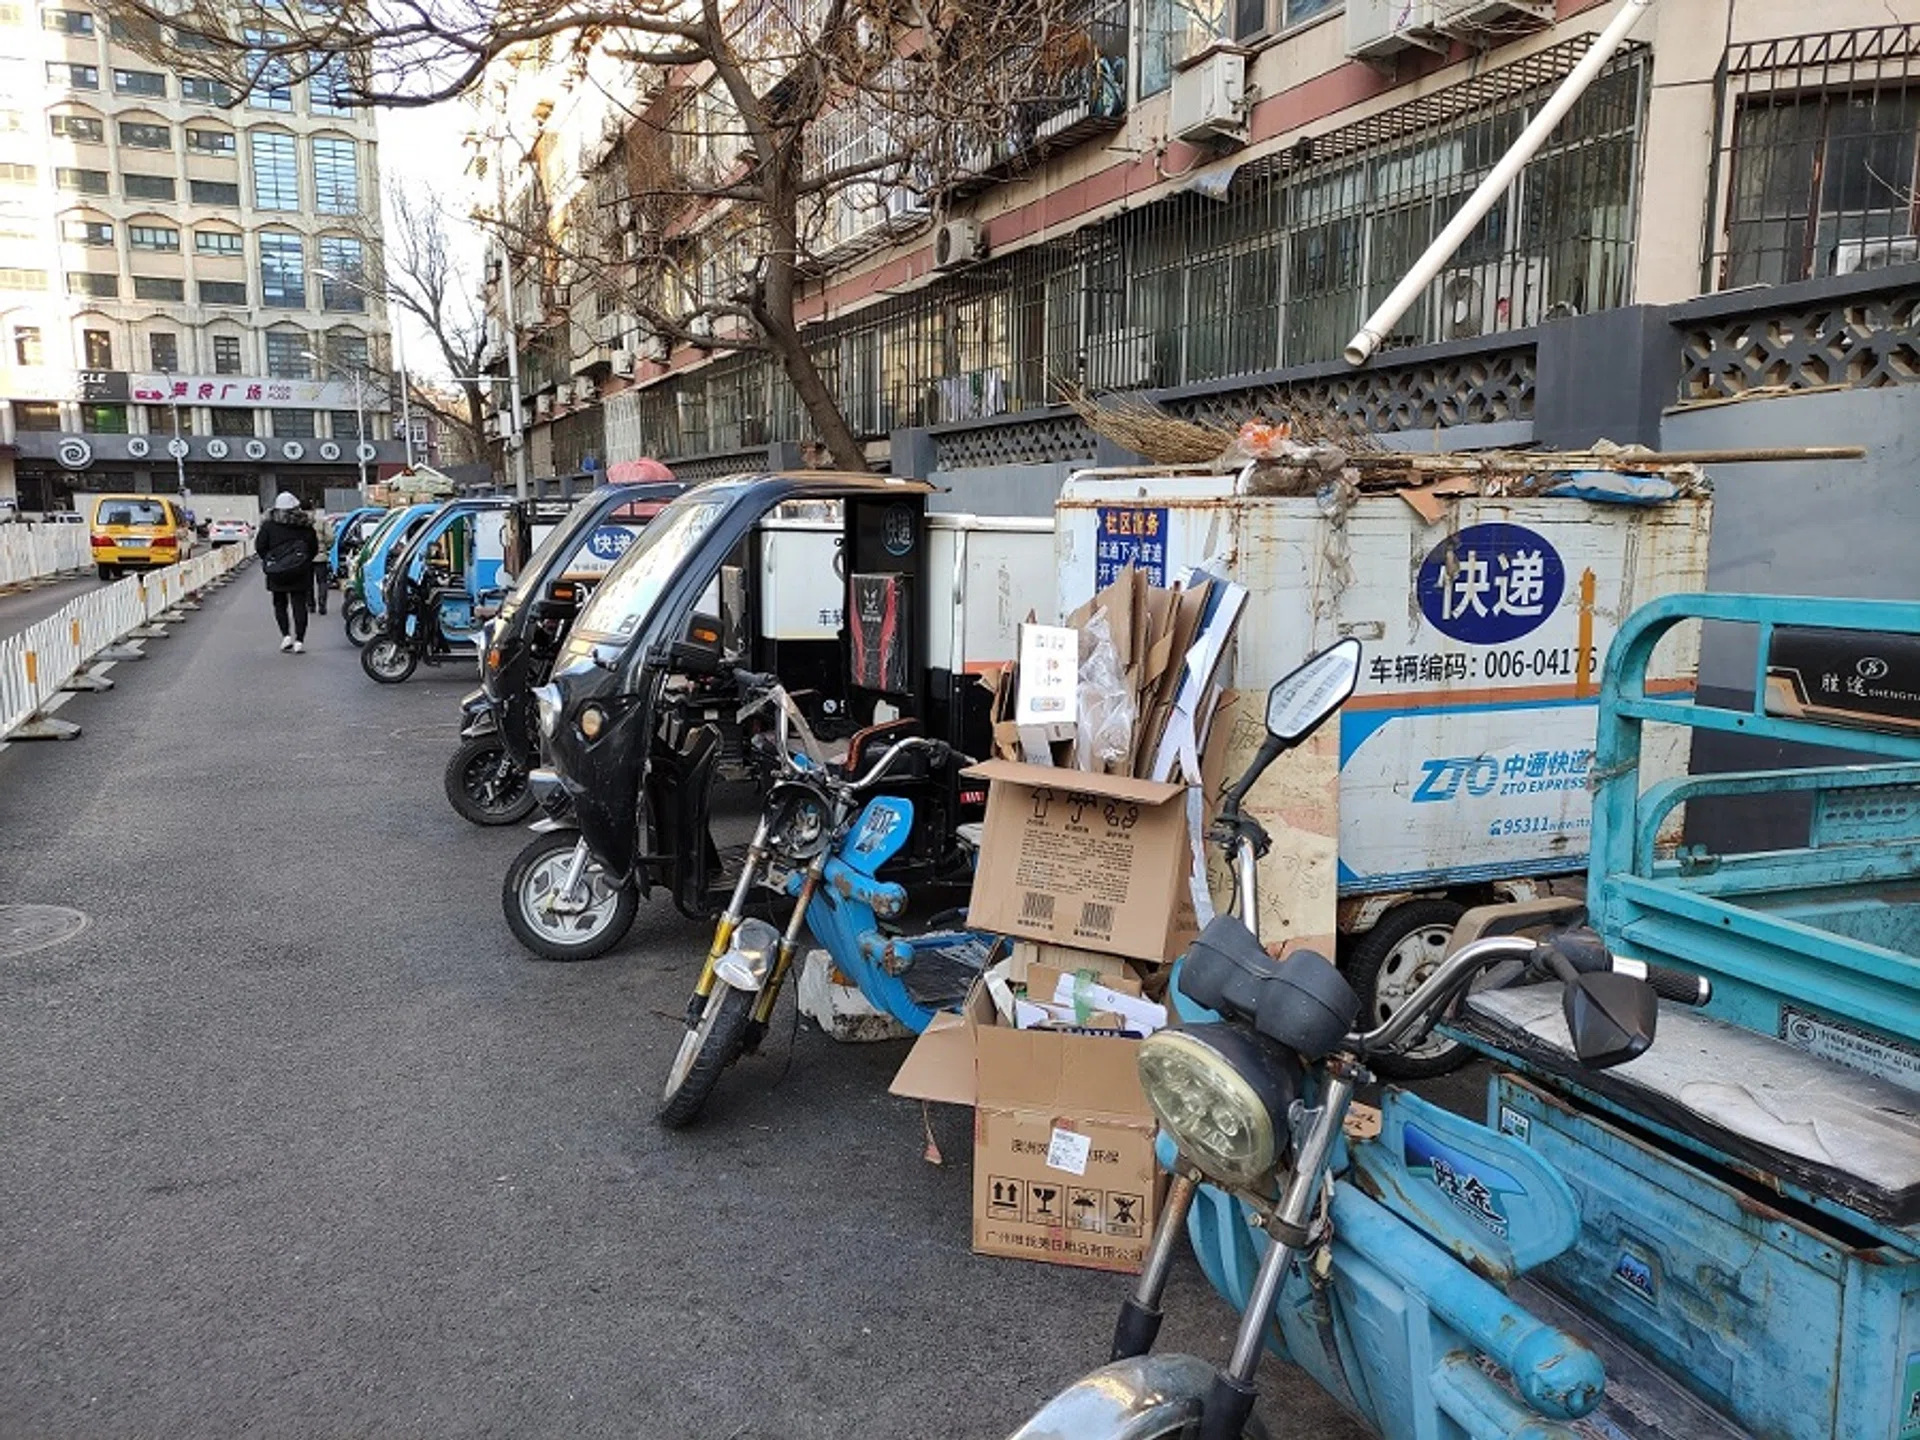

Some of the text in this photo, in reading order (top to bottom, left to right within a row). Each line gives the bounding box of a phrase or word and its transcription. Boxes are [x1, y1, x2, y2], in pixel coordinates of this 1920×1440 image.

[1437, 550, 1546, 620] 快递
[1412, 757, 1499, 803] ZTO
[1503, 749, 1591, 780] 中通快递
[1500, 776, 1589, 796] ZTO EXPRESS
[1503, 817, 1549, 835] 95311
